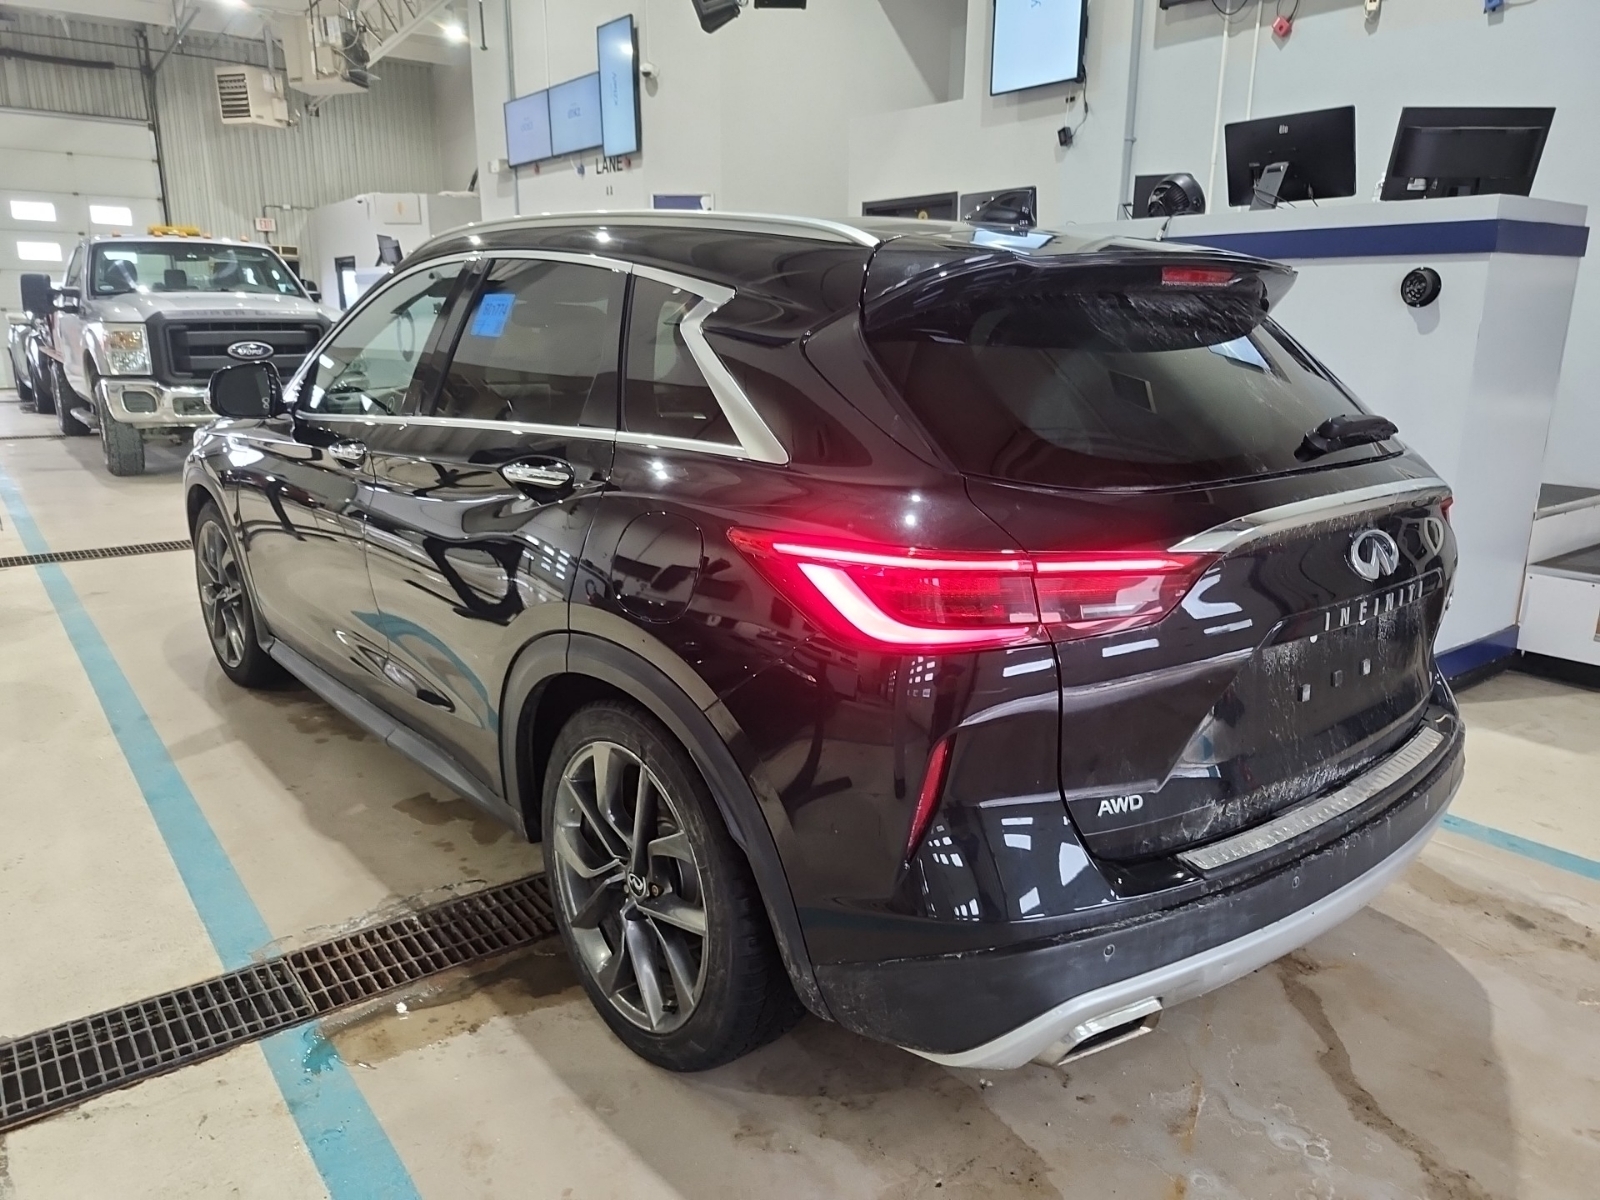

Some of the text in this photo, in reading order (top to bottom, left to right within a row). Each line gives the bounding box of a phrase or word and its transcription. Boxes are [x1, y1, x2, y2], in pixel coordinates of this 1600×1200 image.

[595, 156, 624, 175] LANE
[259, 219, 273, 230] EXIT
[237, 345, 264, 356] Ford
[1325, 580, 1423, 632] INFINITI
[1097, 794, 1144, 817] AWD
